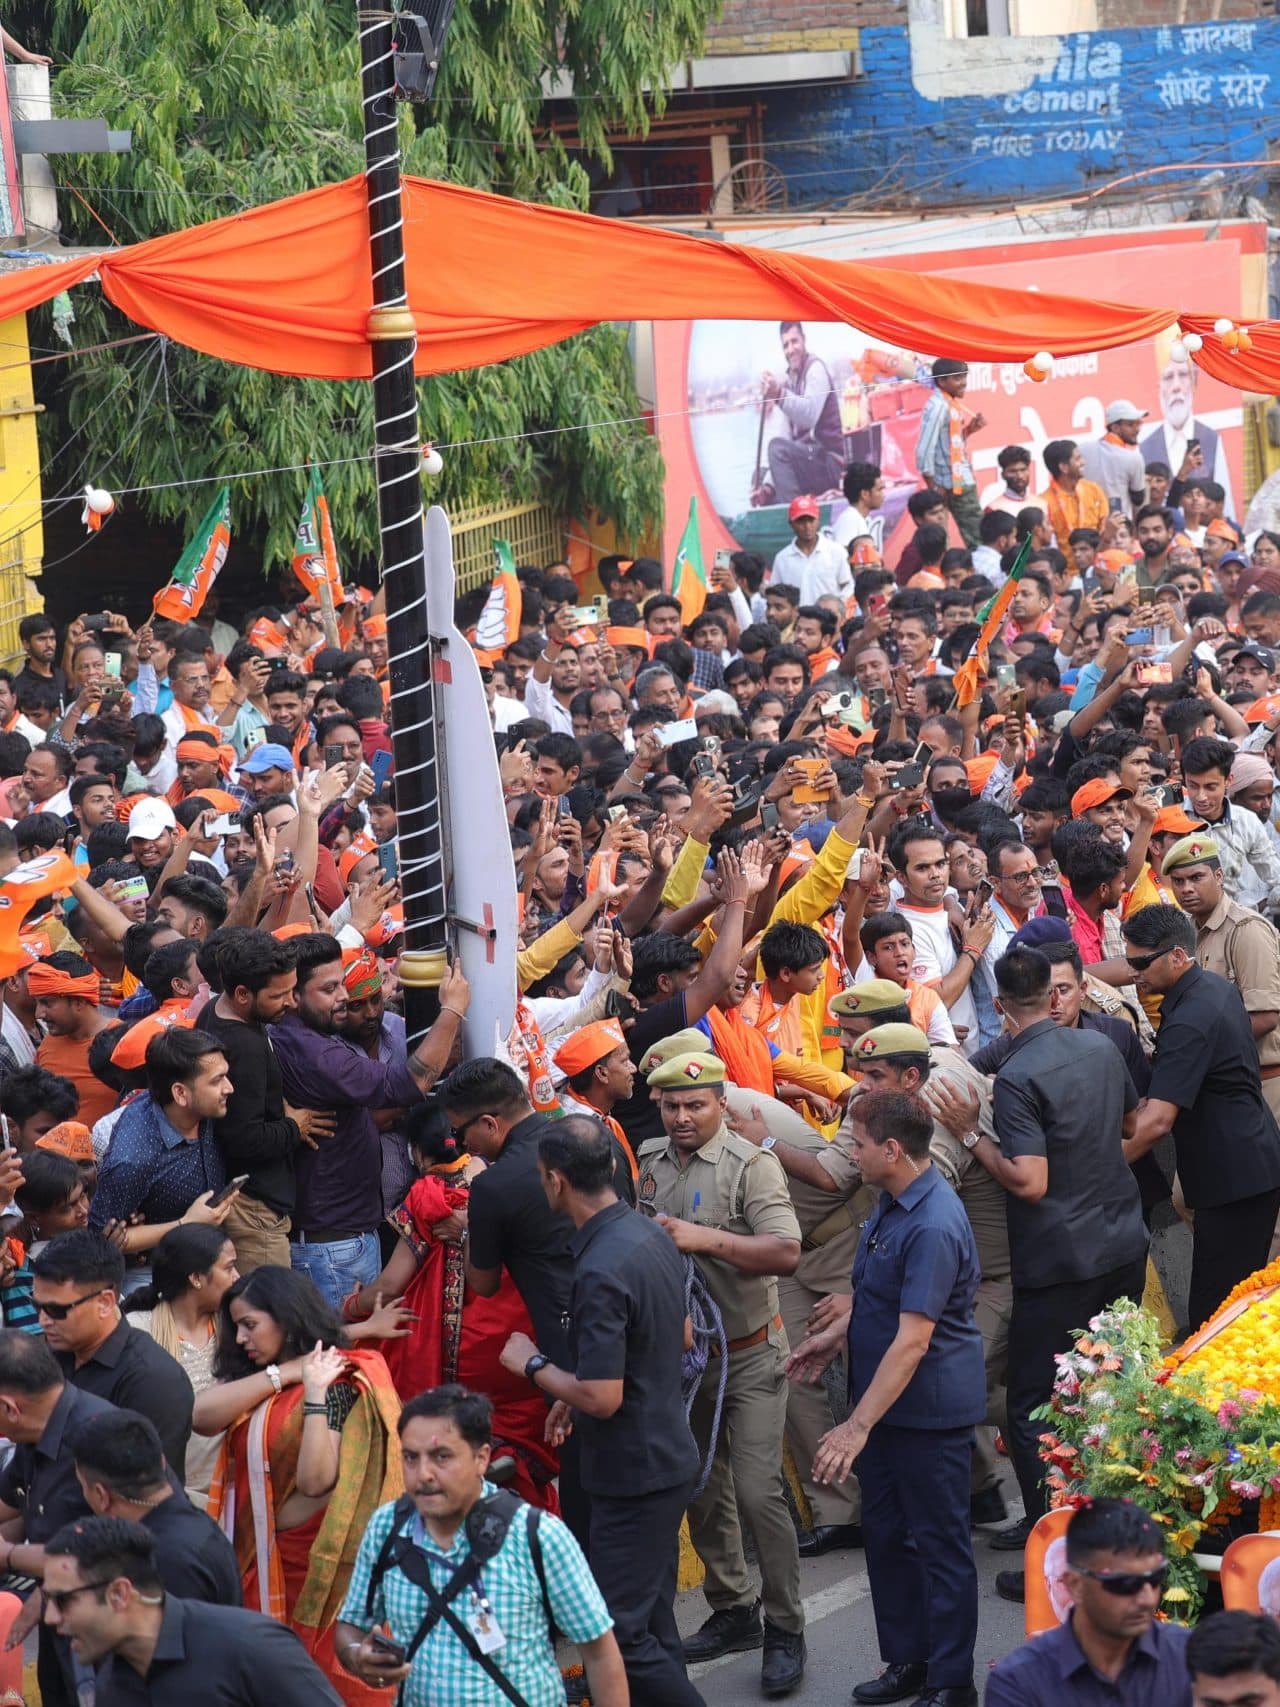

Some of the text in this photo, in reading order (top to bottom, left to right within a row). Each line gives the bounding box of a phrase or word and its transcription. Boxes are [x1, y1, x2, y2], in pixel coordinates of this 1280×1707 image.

[1004, 82, 1123, 116] cement
[1218, 63, 1270, 110] स्टोर
[1044, 129, 1123, 153] TODAY
